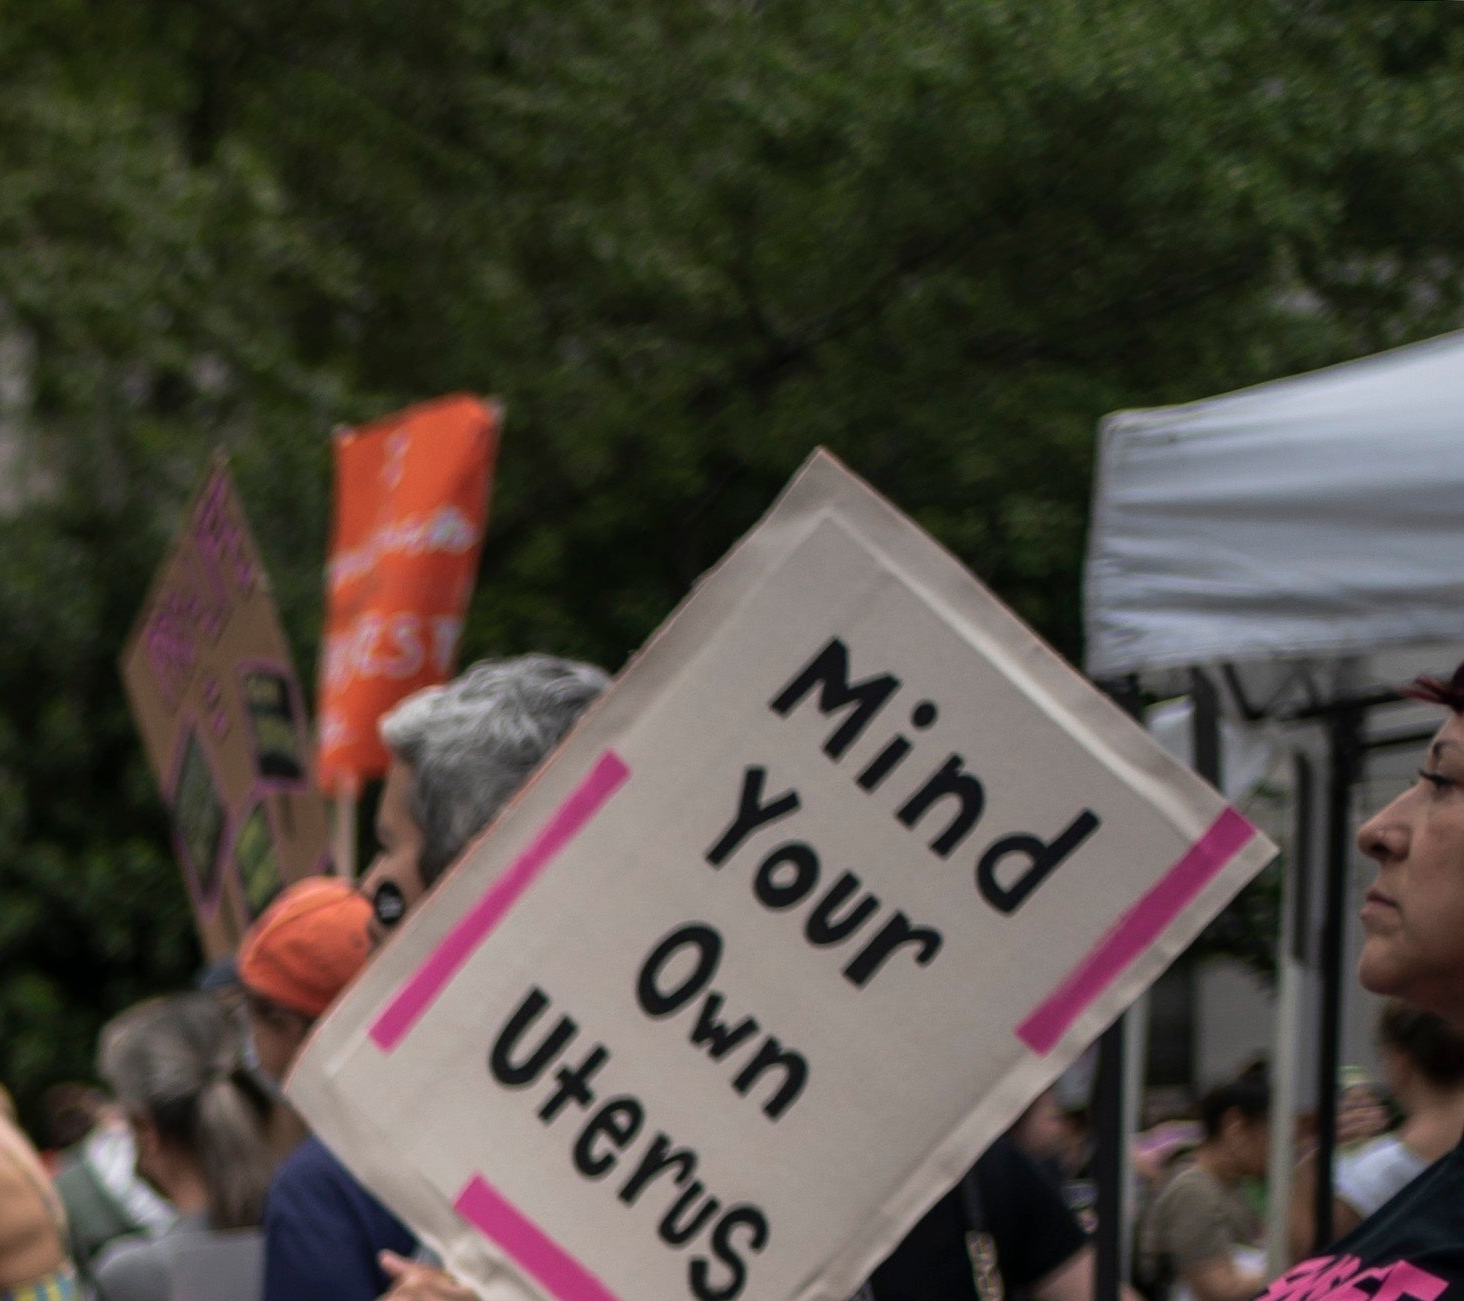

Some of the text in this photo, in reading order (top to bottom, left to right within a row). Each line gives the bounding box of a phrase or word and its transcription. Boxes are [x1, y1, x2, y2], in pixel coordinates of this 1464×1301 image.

[705, 766, 944, 989] Your
[769, 636, 1102, 917] Mind
[635, 922, 810, 1122] Own
